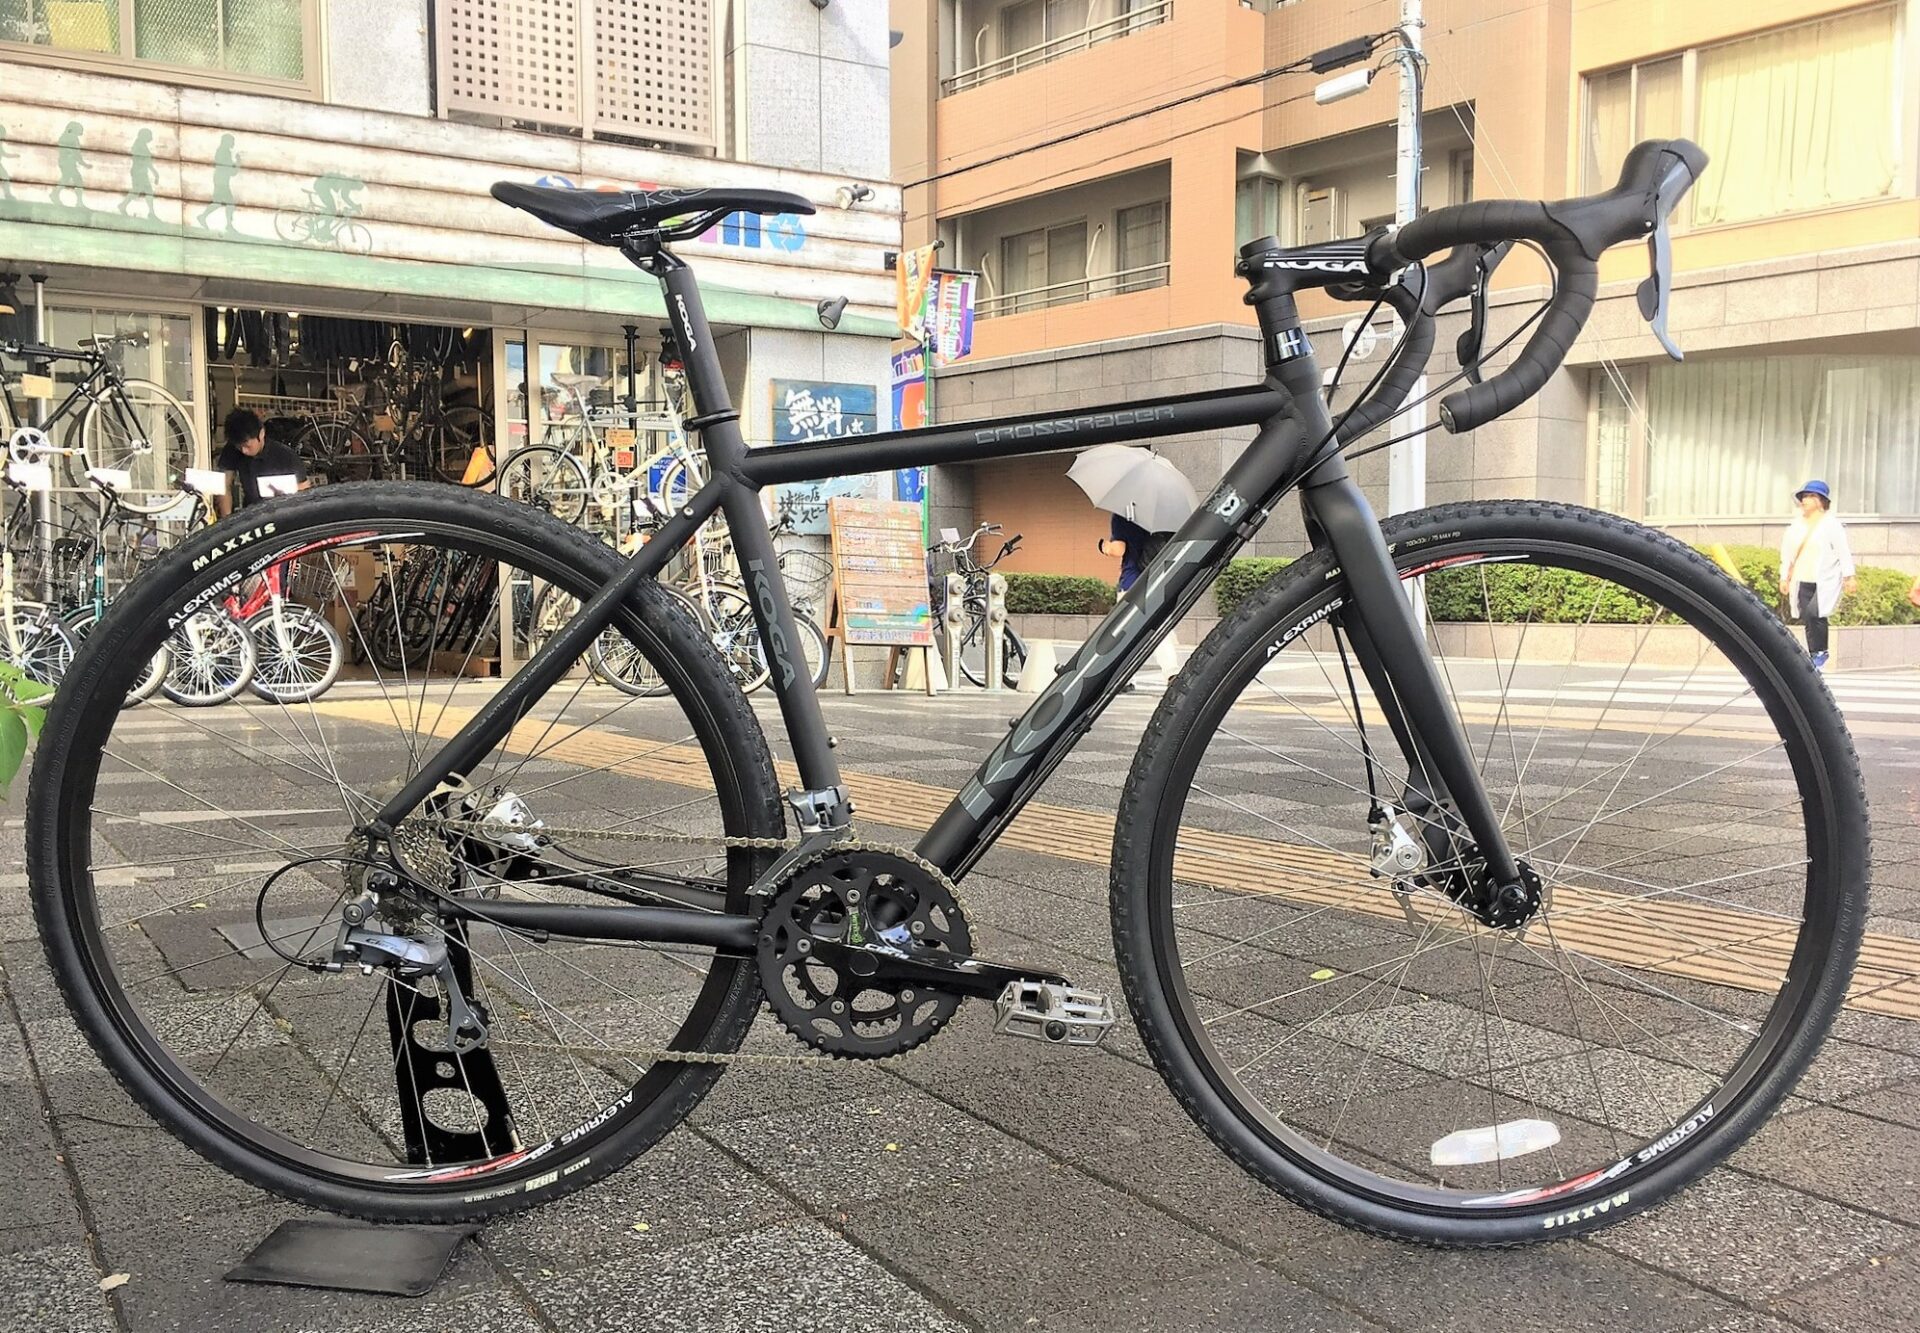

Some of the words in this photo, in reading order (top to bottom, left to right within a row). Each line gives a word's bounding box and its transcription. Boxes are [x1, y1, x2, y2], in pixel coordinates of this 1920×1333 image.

[675, 294, 697, 352] KOGA
[785, 388, 844, 435] 無料
[974, 405, 1175, 444] CROSSRACER
[801, 506, 828, 523] スピー
[192, 522, 277, 571] MAXXIS
[167, 570, 242, 629] ALEXRIMS
[748, 558, 796, 691] KOGA
[1266, 597, 1343, 658] ALEXRIMS
[958, 539, 1219, 821] KOGA
[560, 1090, 633, 1145] ALEXRIMS
[1638, 1103, 1715, 1163] ALEXRIMS
[563, 1156, 591, 1176] MAXXIS
[1543, 1191, 1630, 1229] MAXXIS
